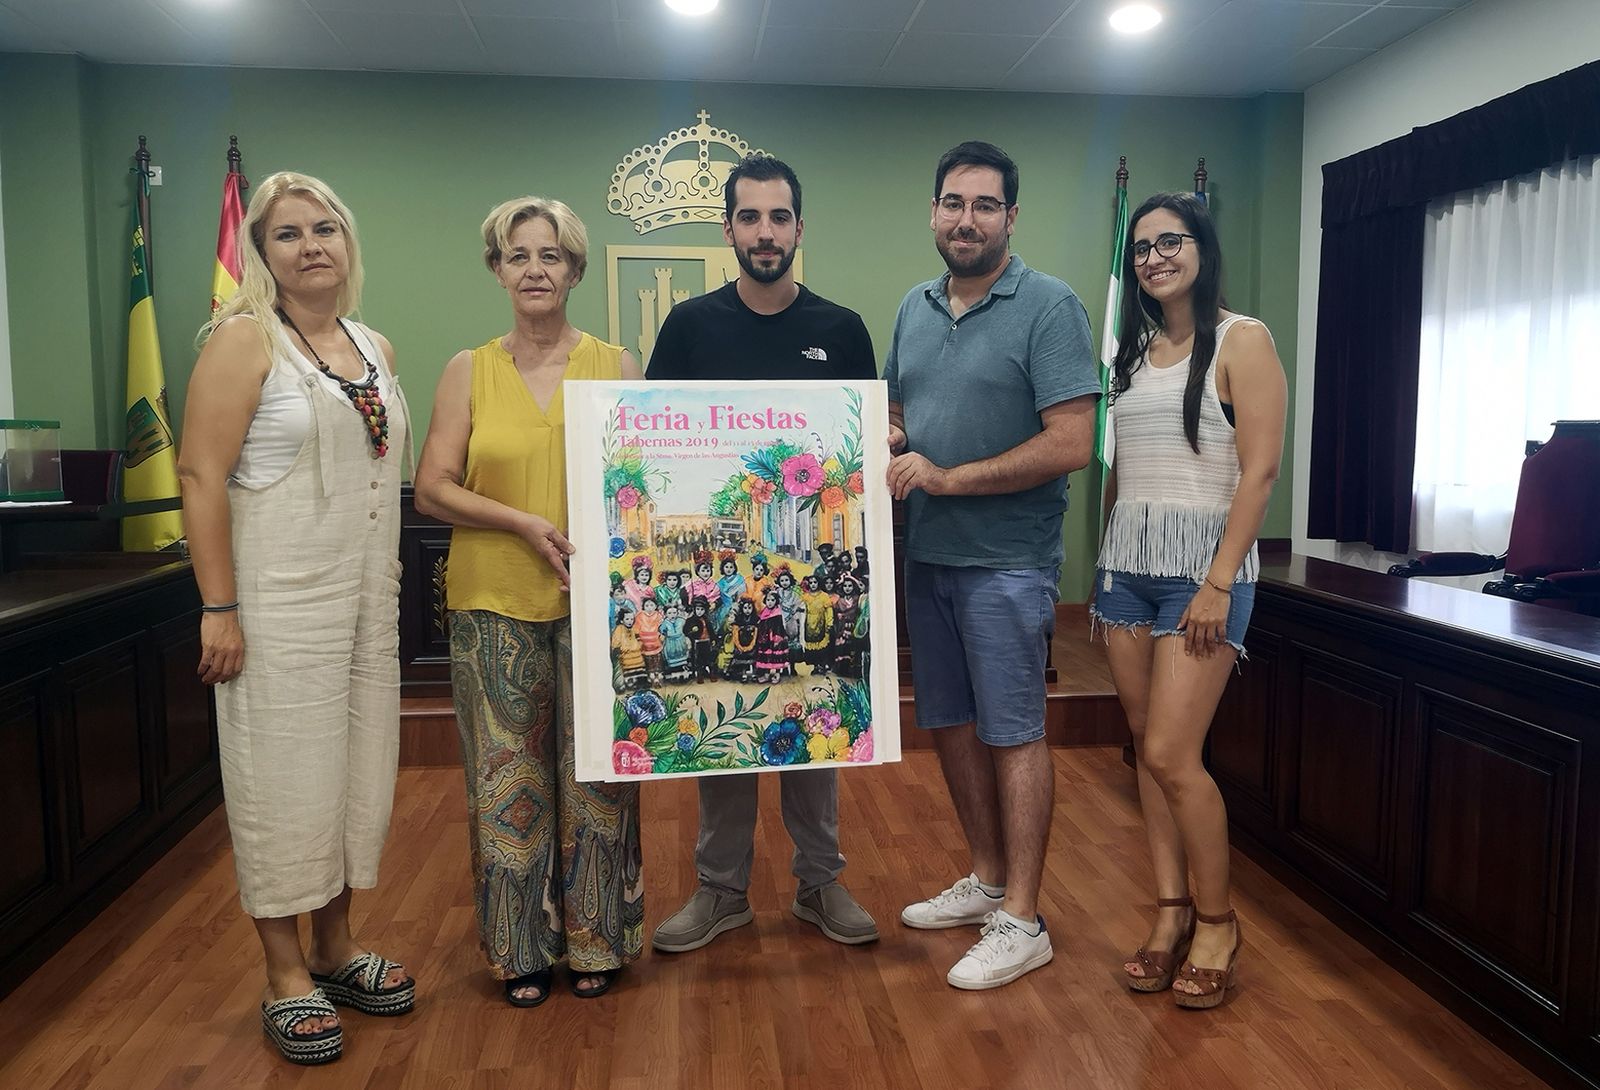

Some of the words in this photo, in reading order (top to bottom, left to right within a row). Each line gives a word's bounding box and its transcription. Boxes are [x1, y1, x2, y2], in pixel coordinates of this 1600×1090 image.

[617, 405, 690, 431] Feria
[697, 421, 705, 434] y
[708, 404, 807, 431] Fiestas
[617, 435, 682, 448] Tabernas
[685, 436, 719, 448] 2019
